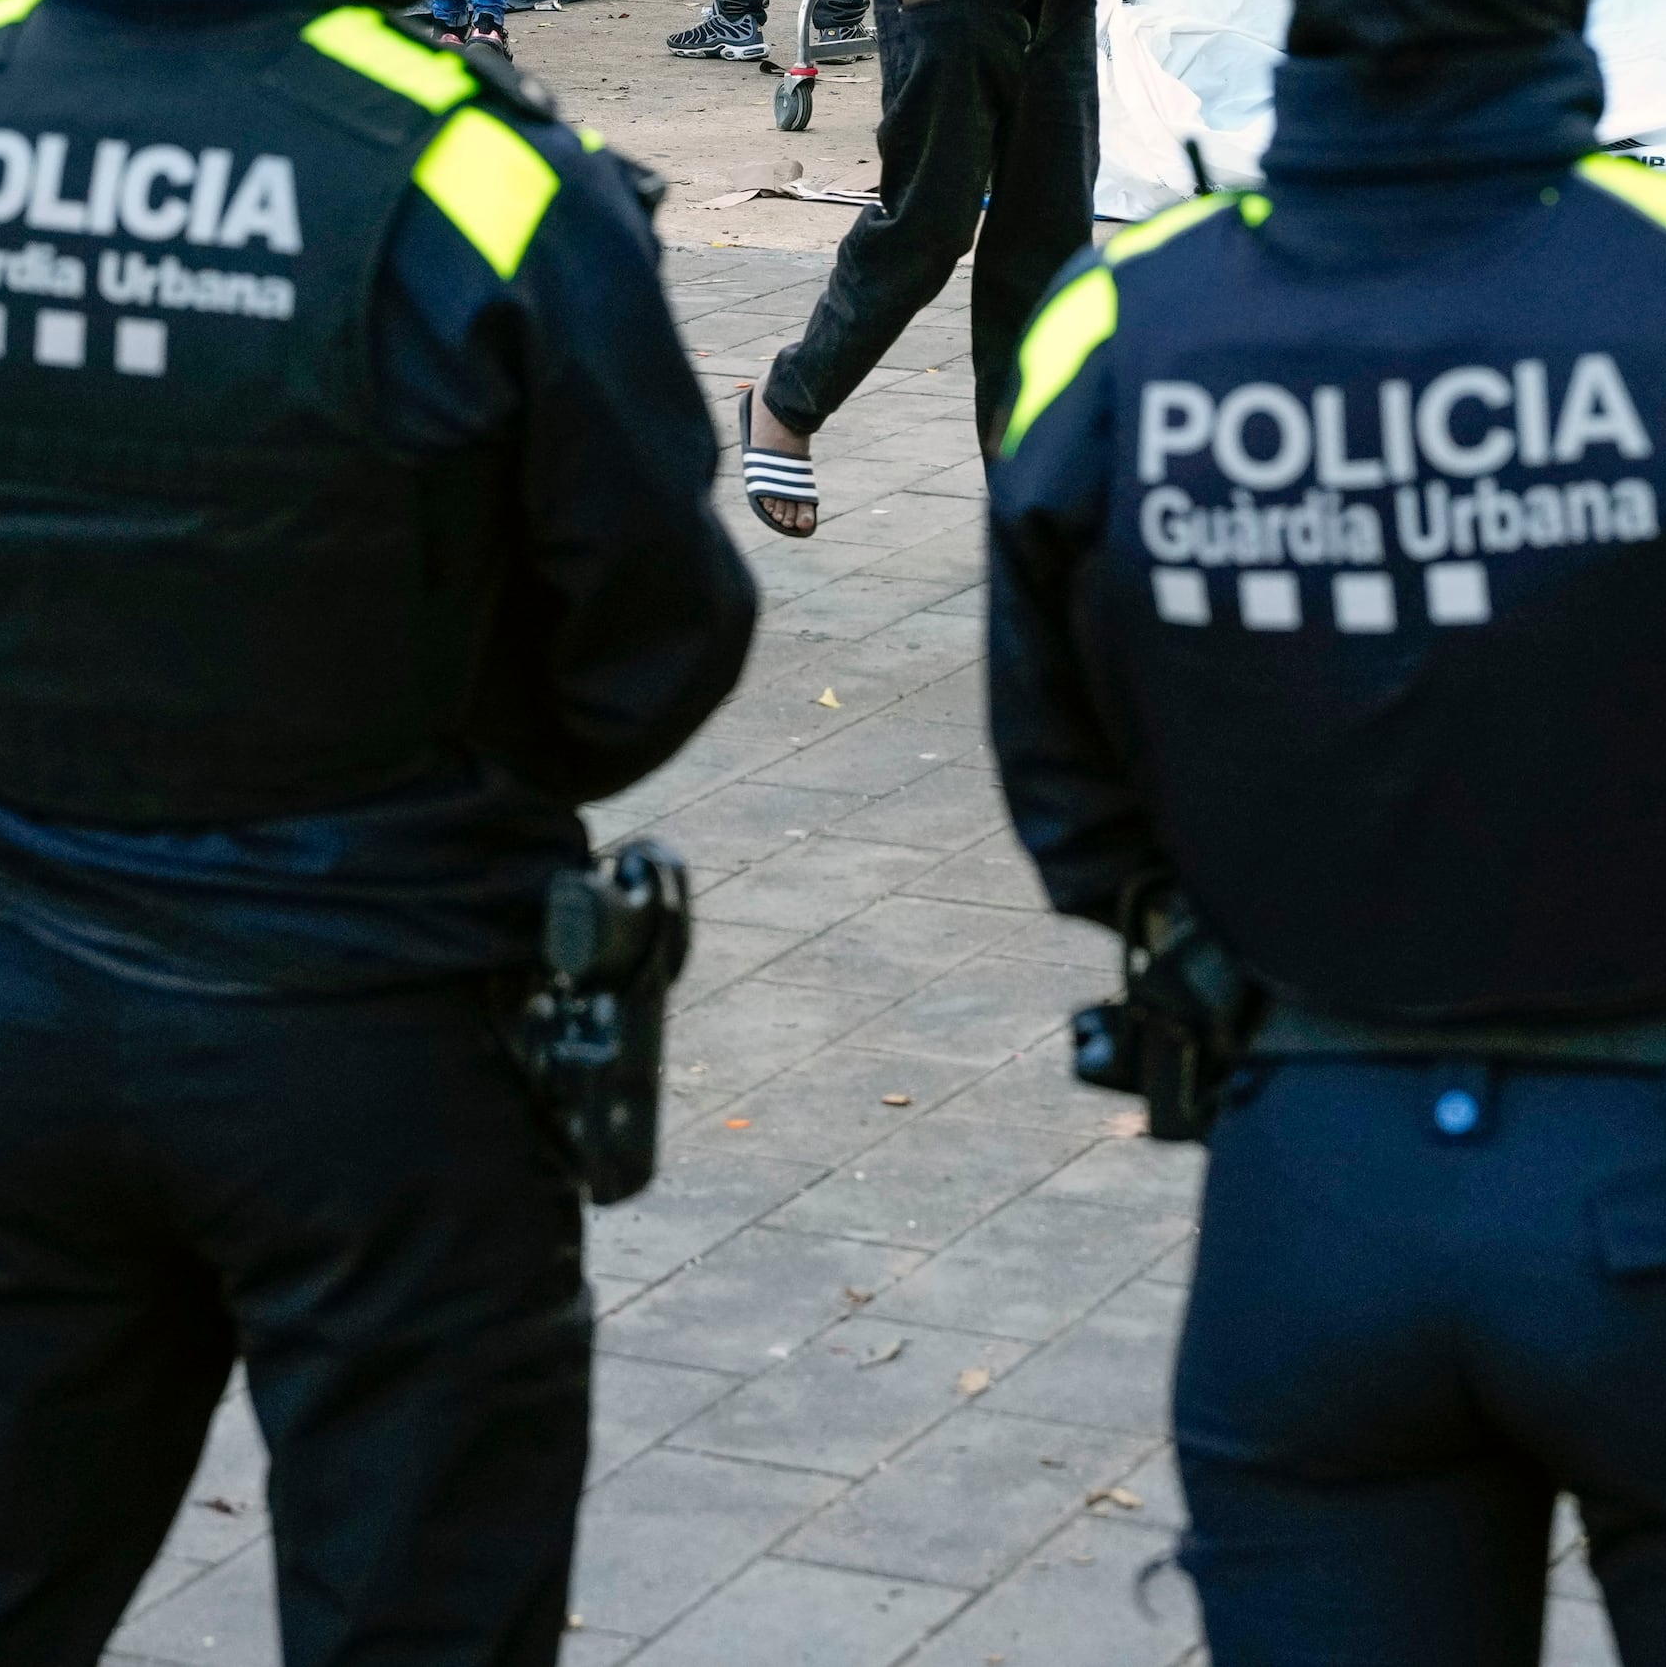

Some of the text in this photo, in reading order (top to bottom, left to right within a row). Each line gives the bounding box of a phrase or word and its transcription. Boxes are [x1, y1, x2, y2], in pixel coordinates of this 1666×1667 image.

[98, 248, 296, 320] Urbana
[1138, 351, 1652, 490] POLICIA
[1139, 476, 1660, 566] Guàrdia Urbana
